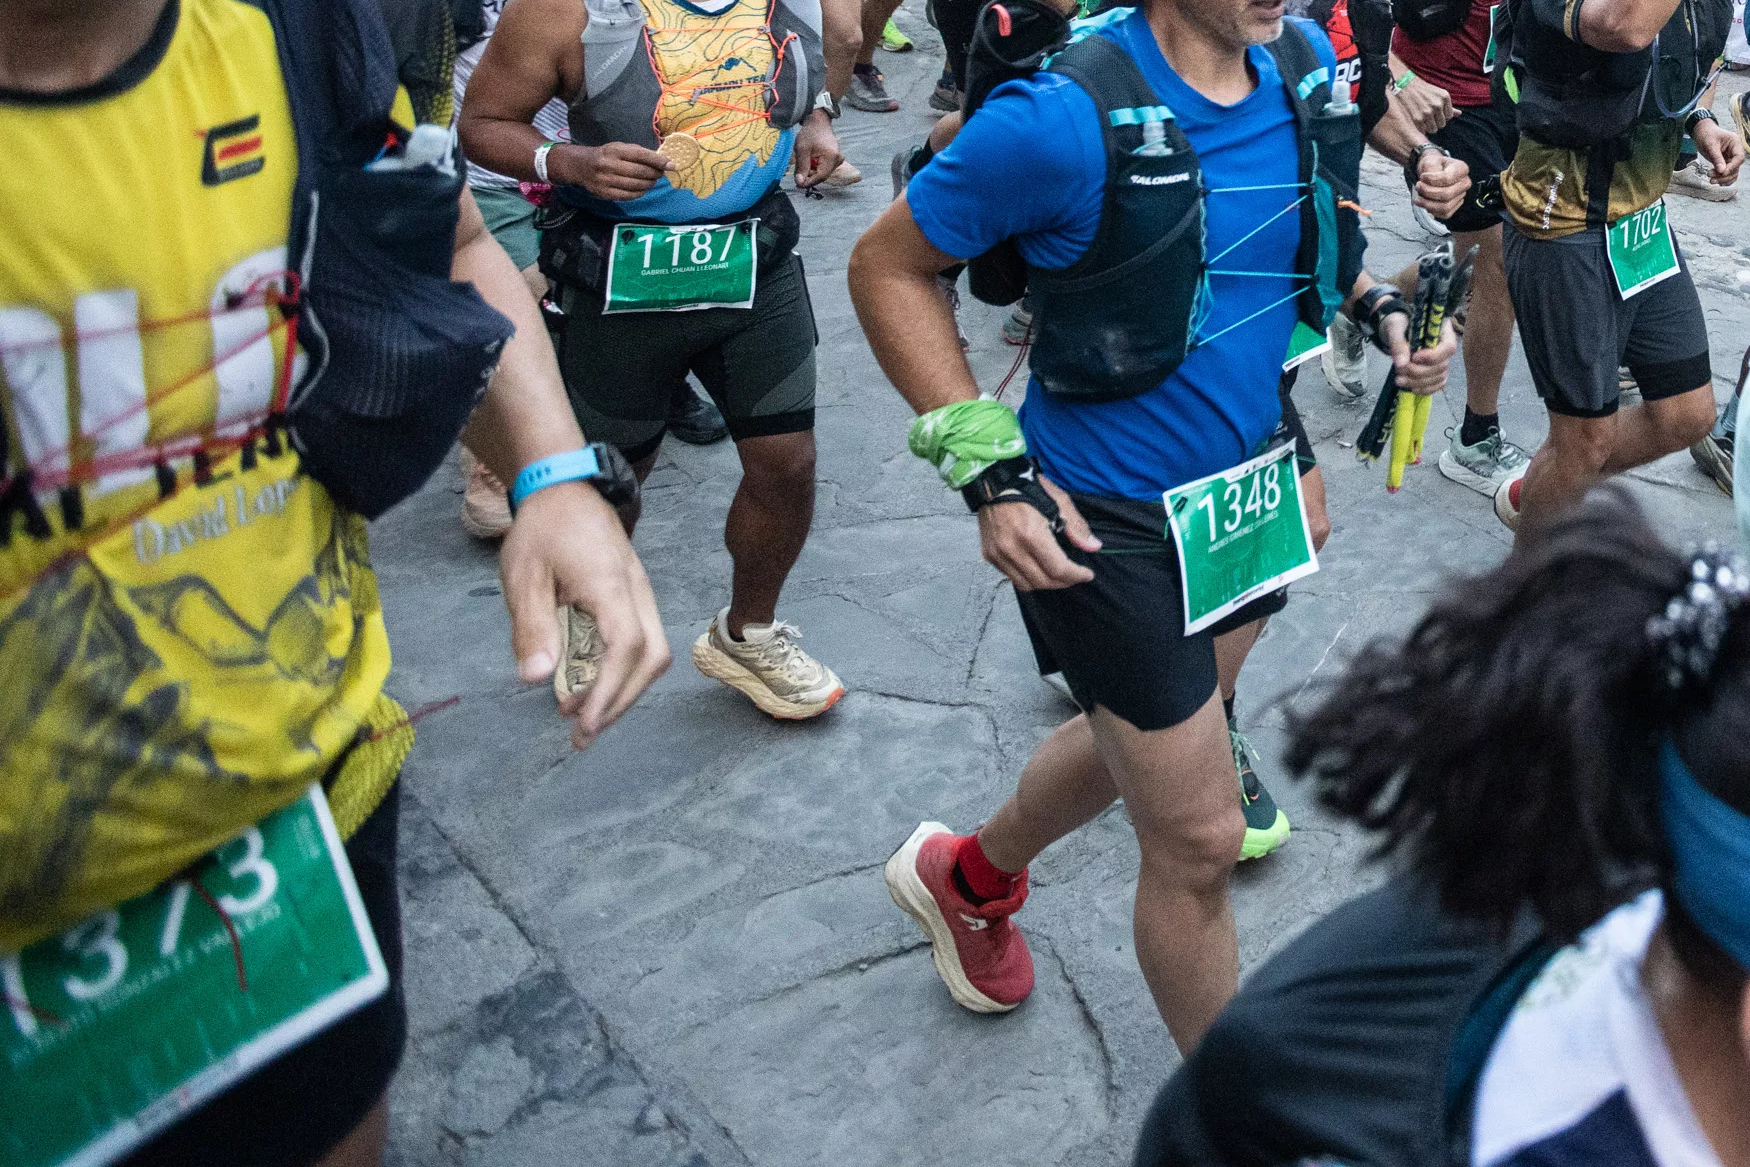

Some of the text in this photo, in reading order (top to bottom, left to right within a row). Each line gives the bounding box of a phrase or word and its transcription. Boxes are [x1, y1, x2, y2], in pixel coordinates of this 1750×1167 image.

[1130, 172, 1190, 185] SALOMON
[637, 226, 736, 268] 1187
[1620, 206, 1661, 248] 1702
[641, 268, 669, 276] GABRIEL
[1198, 463, 1281, 542] 1348
